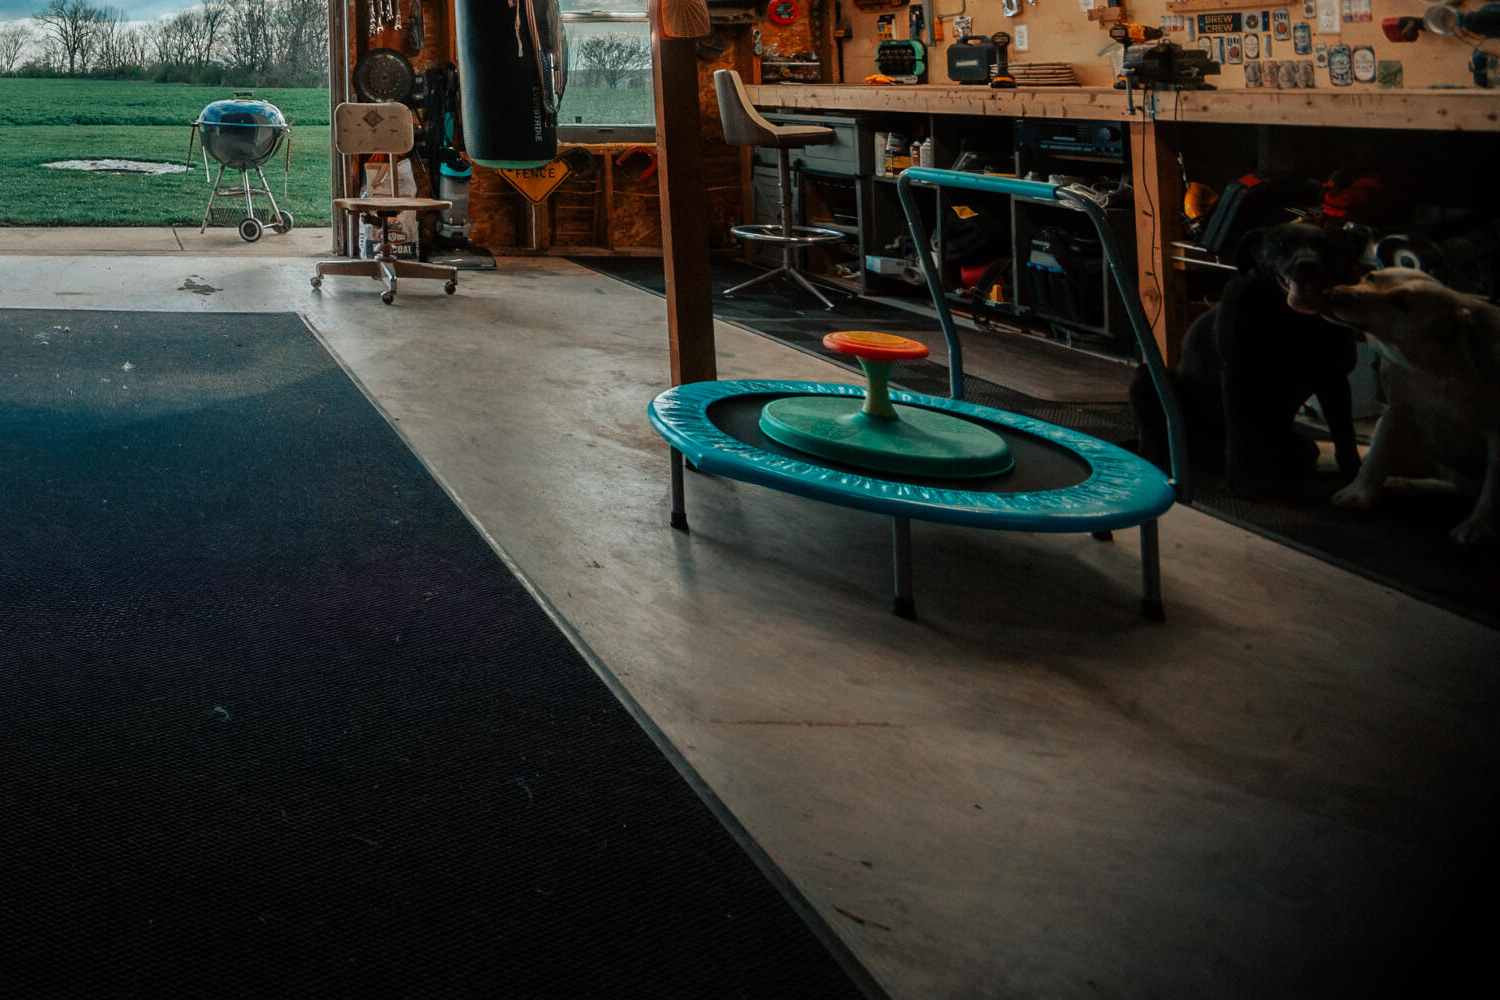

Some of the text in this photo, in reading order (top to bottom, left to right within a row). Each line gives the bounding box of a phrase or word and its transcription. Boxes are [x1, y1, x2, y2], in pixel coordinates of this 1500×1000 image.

[1204, 15, 1233, 24] BREW
[1205, 24, 1234, 33] CREW
[515, 167, 556, 179] FENCE
